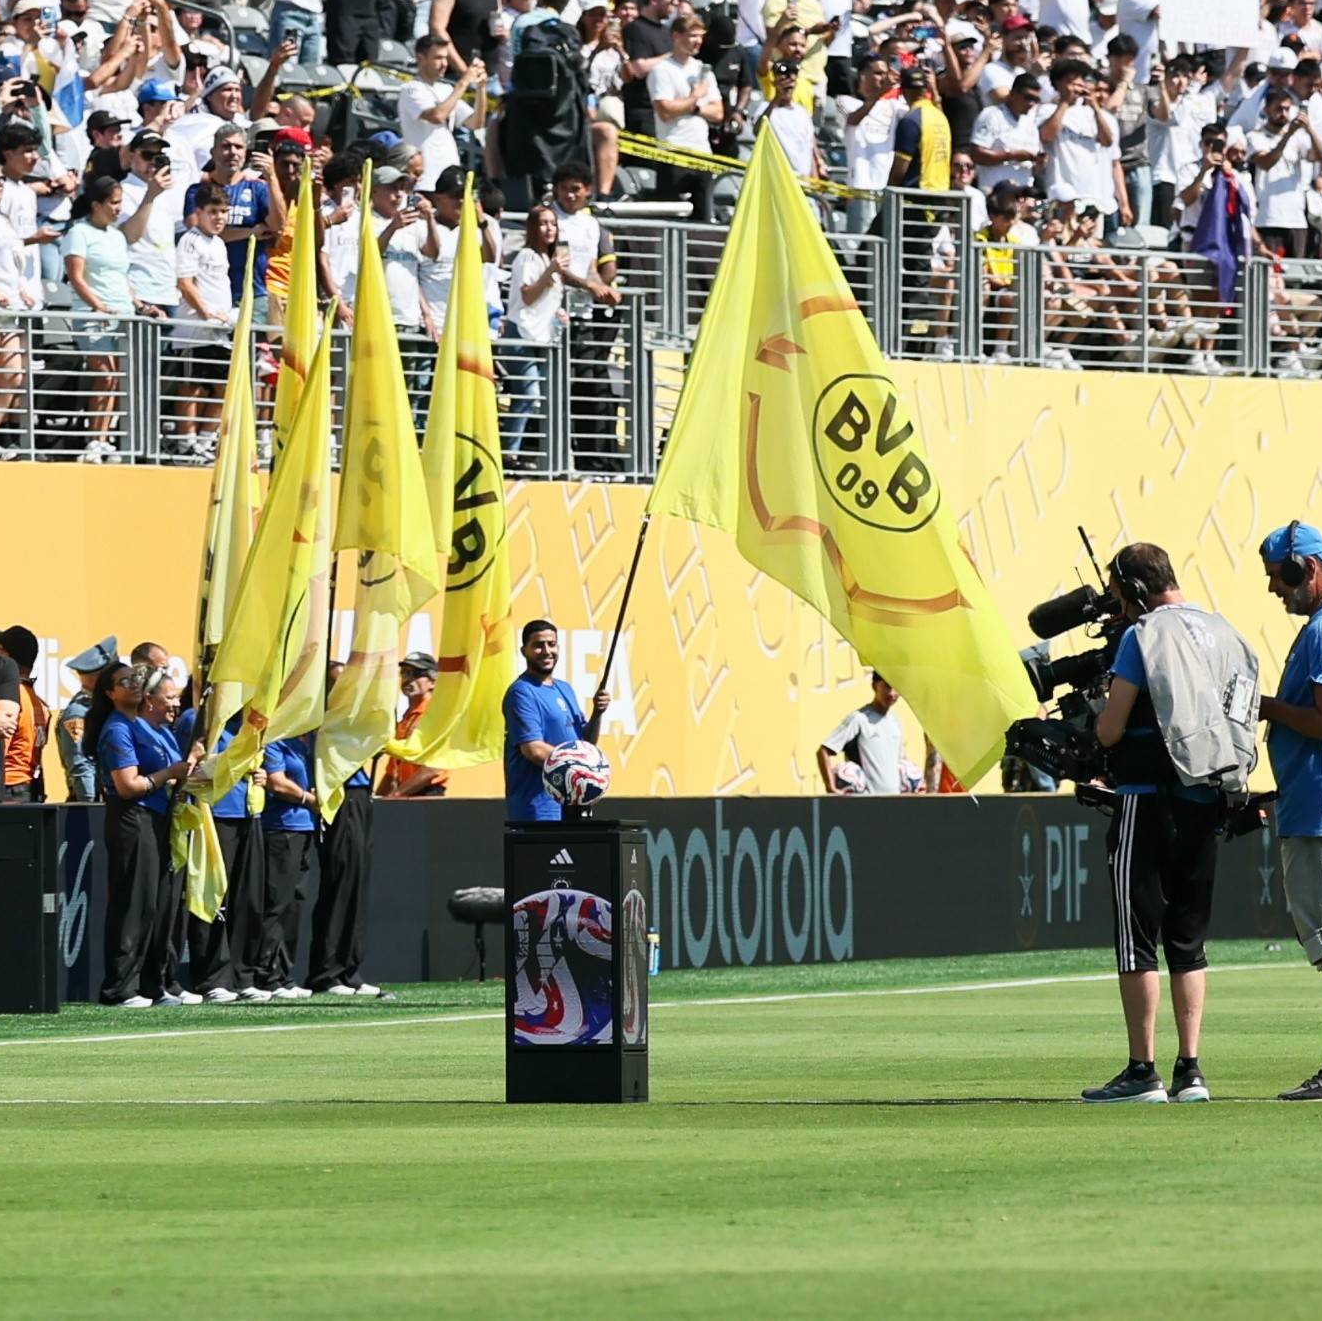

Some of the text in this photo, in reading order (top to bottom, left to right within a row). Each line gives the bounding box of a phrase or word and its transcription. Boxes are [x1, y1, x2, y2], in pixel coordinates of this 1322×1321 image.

[824, 389, 931, 515] BVB
[836, 462, 879, 509] 09
[446, 457, 499, 575] VB
[642, 799, 855, 968] motorola
[1046, 825, 1090, 924] PIF
